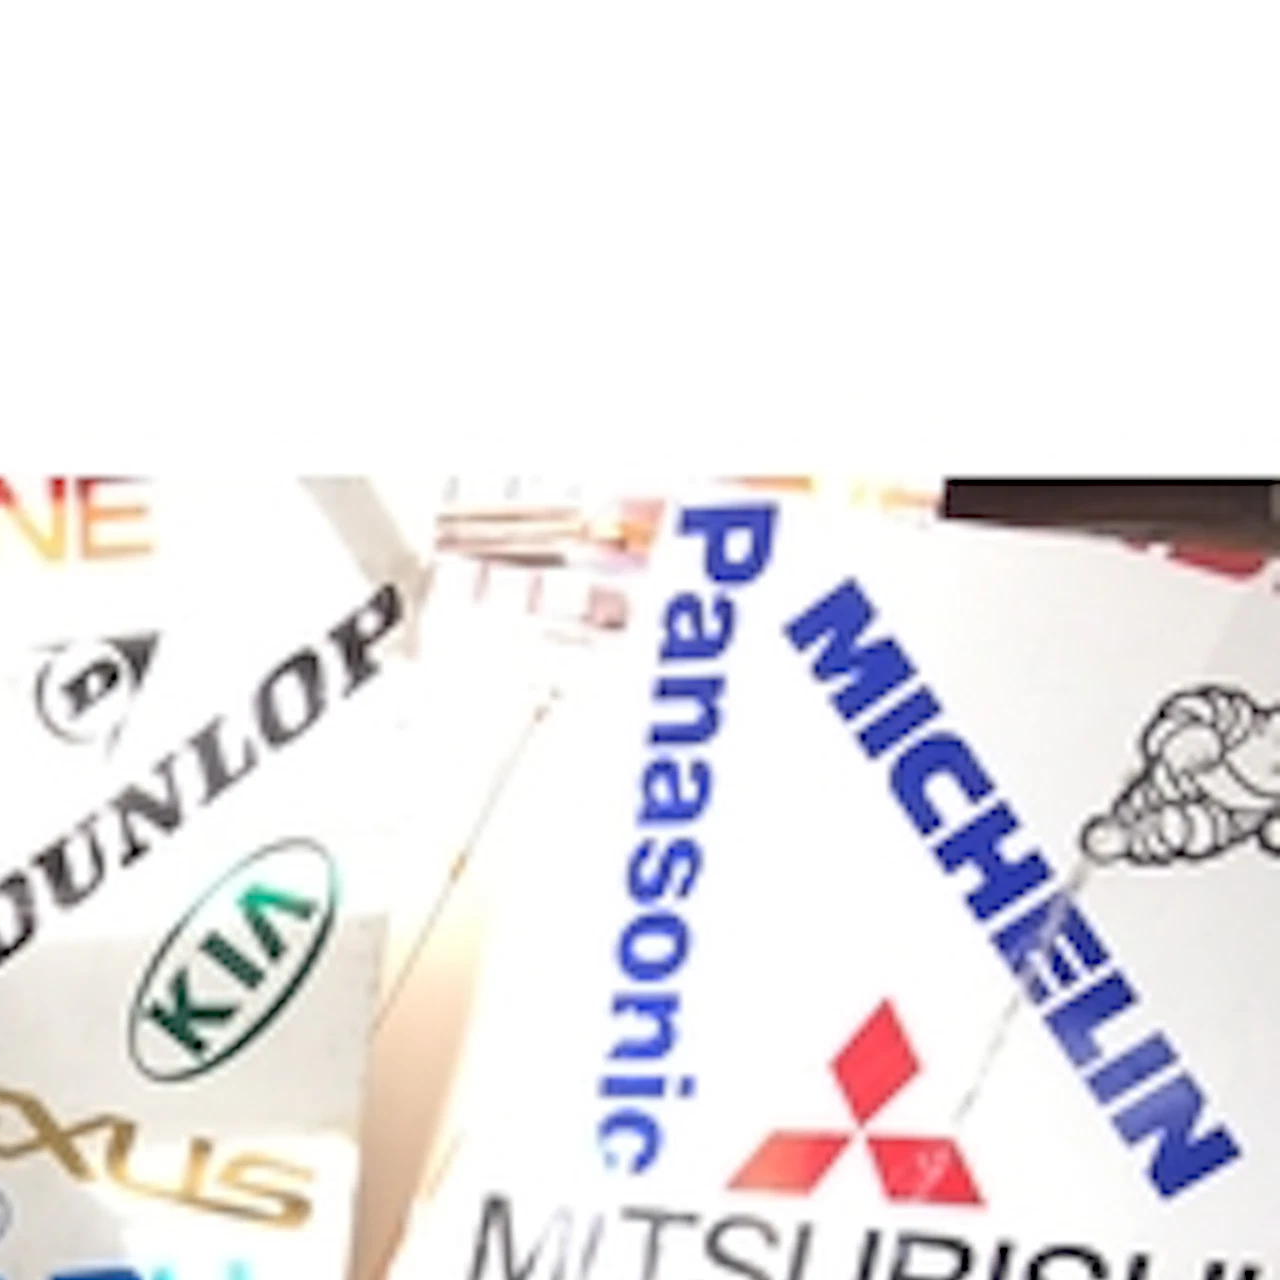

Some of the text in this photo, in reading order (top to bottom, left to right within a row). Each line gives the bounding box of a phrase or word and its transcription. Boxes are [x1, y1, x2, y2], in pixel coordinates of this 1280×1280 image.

[143, 878, 320, 1062] KIA
[593, 500, 780, 1178] Panasonic
[782, 578, 1242, 1202] MICHELIN
